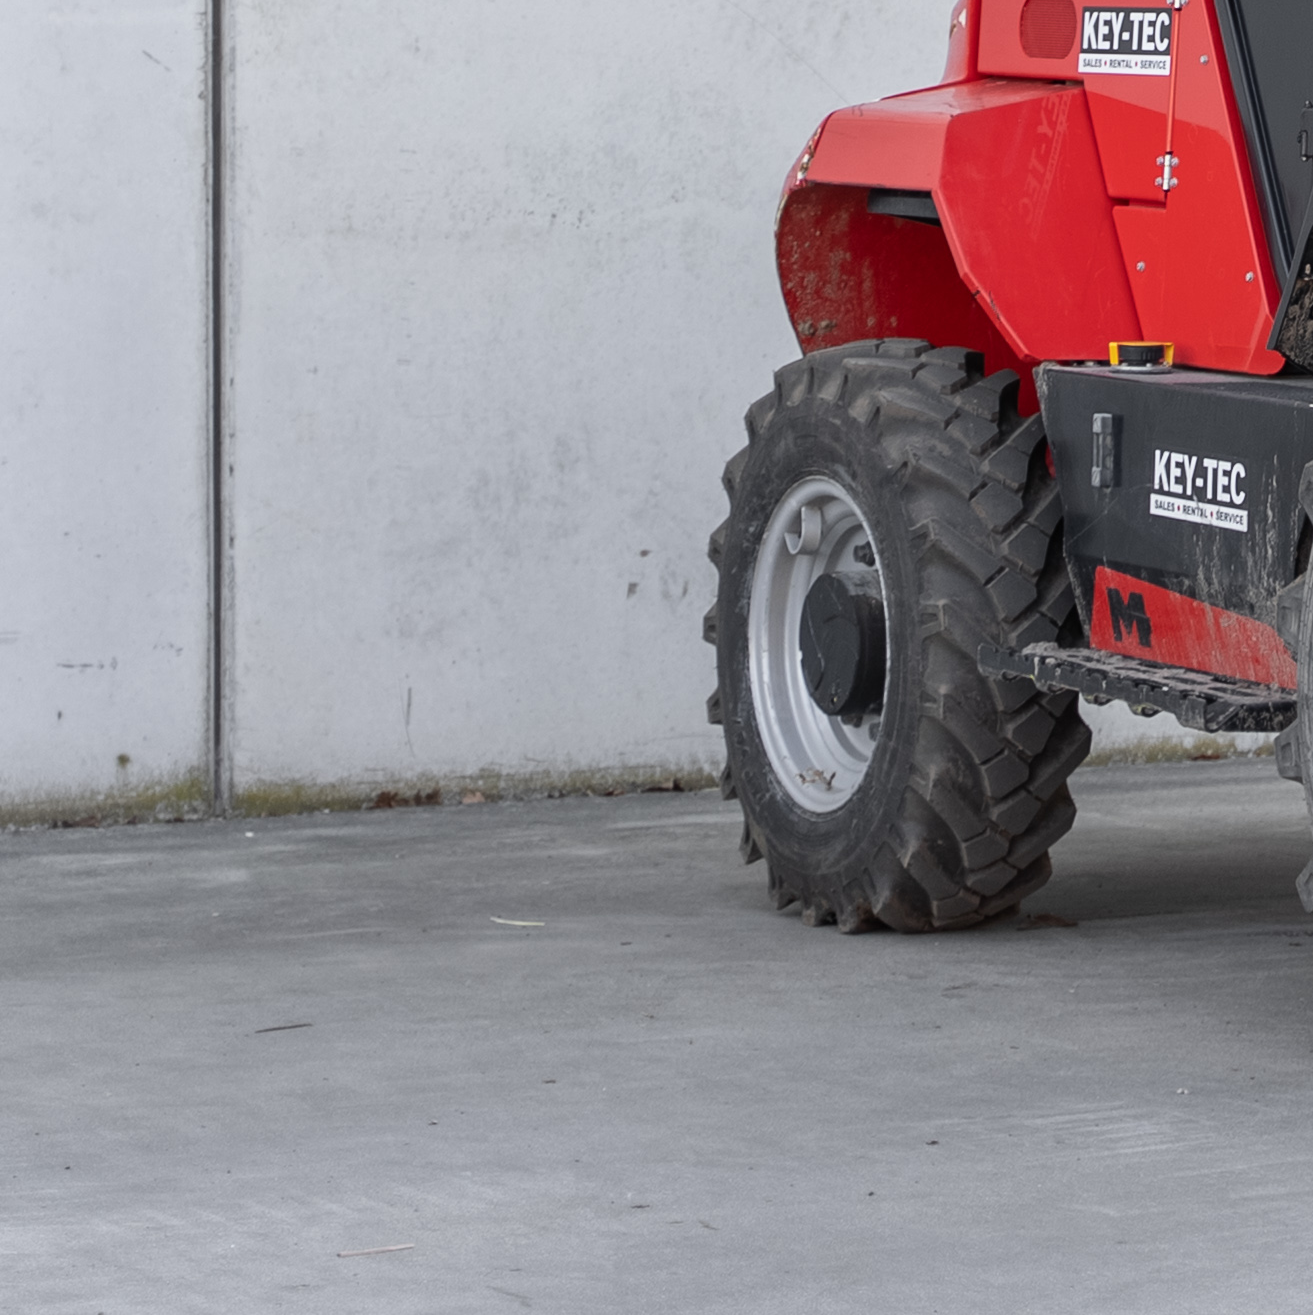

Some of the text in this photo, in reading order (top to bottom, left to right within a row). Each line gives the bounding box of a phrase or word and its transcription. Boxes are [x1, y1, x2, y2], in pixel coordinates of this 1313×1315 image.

[1082, 11, 1170, 52] KEY-TEC
[1083, 58, 1167, 70] SALES RENTAL SERVICE
[1153, 449, 1246, 505] KEY-TEC
[1154, 499, 1175, 512] SALES
[1215, 509, 1244, 525] SERVICE
